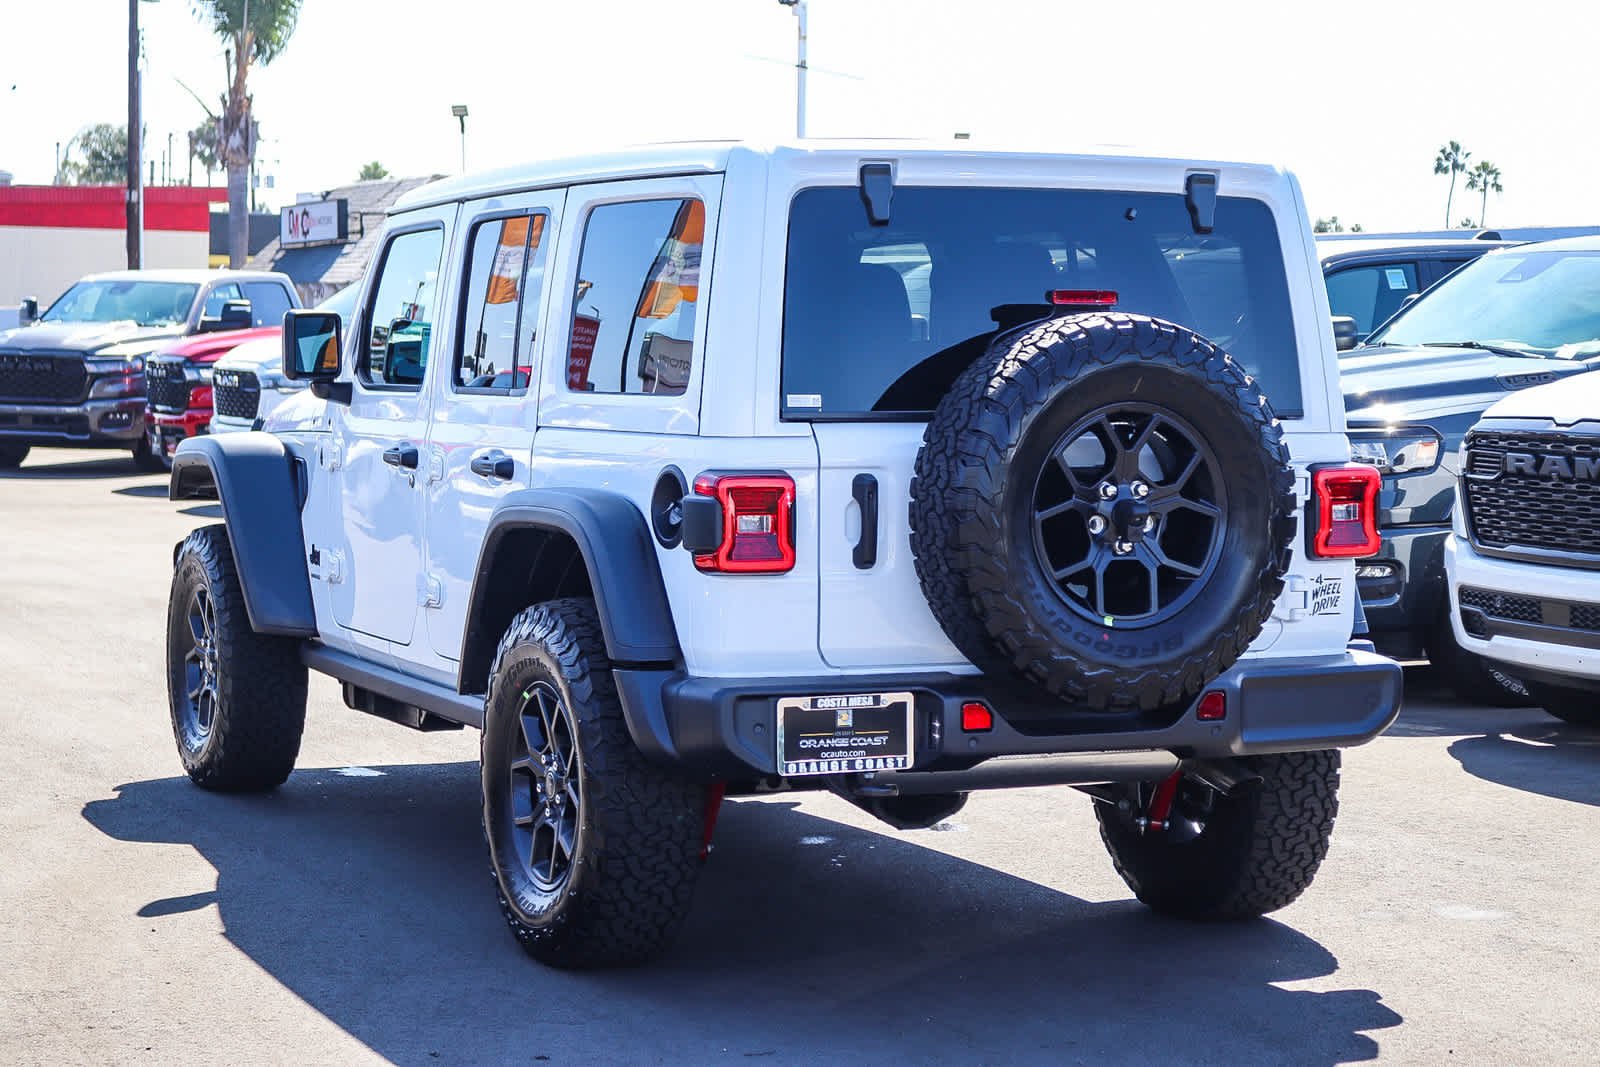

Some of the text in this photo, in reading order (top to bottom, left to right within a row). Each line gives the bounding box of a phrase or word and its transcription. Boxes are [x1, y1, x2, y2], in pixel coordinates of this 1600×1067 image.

[216, 374, 239, 388] RAM
[1506, 452, 1600, 480] RAM
[1315, 573, 1323, 585] 4
[1312, 583, 1341, 600] WHEEL
[1312, 596, 1341, 616] DRIVE
[817, 696, 874, 708] COSTA MESA
[799, 735, 889, 749] ORANGE COAST
[820, 750, 866, 759] ocauto.com
[788, 757, 905, 774] ORANGE COAST
